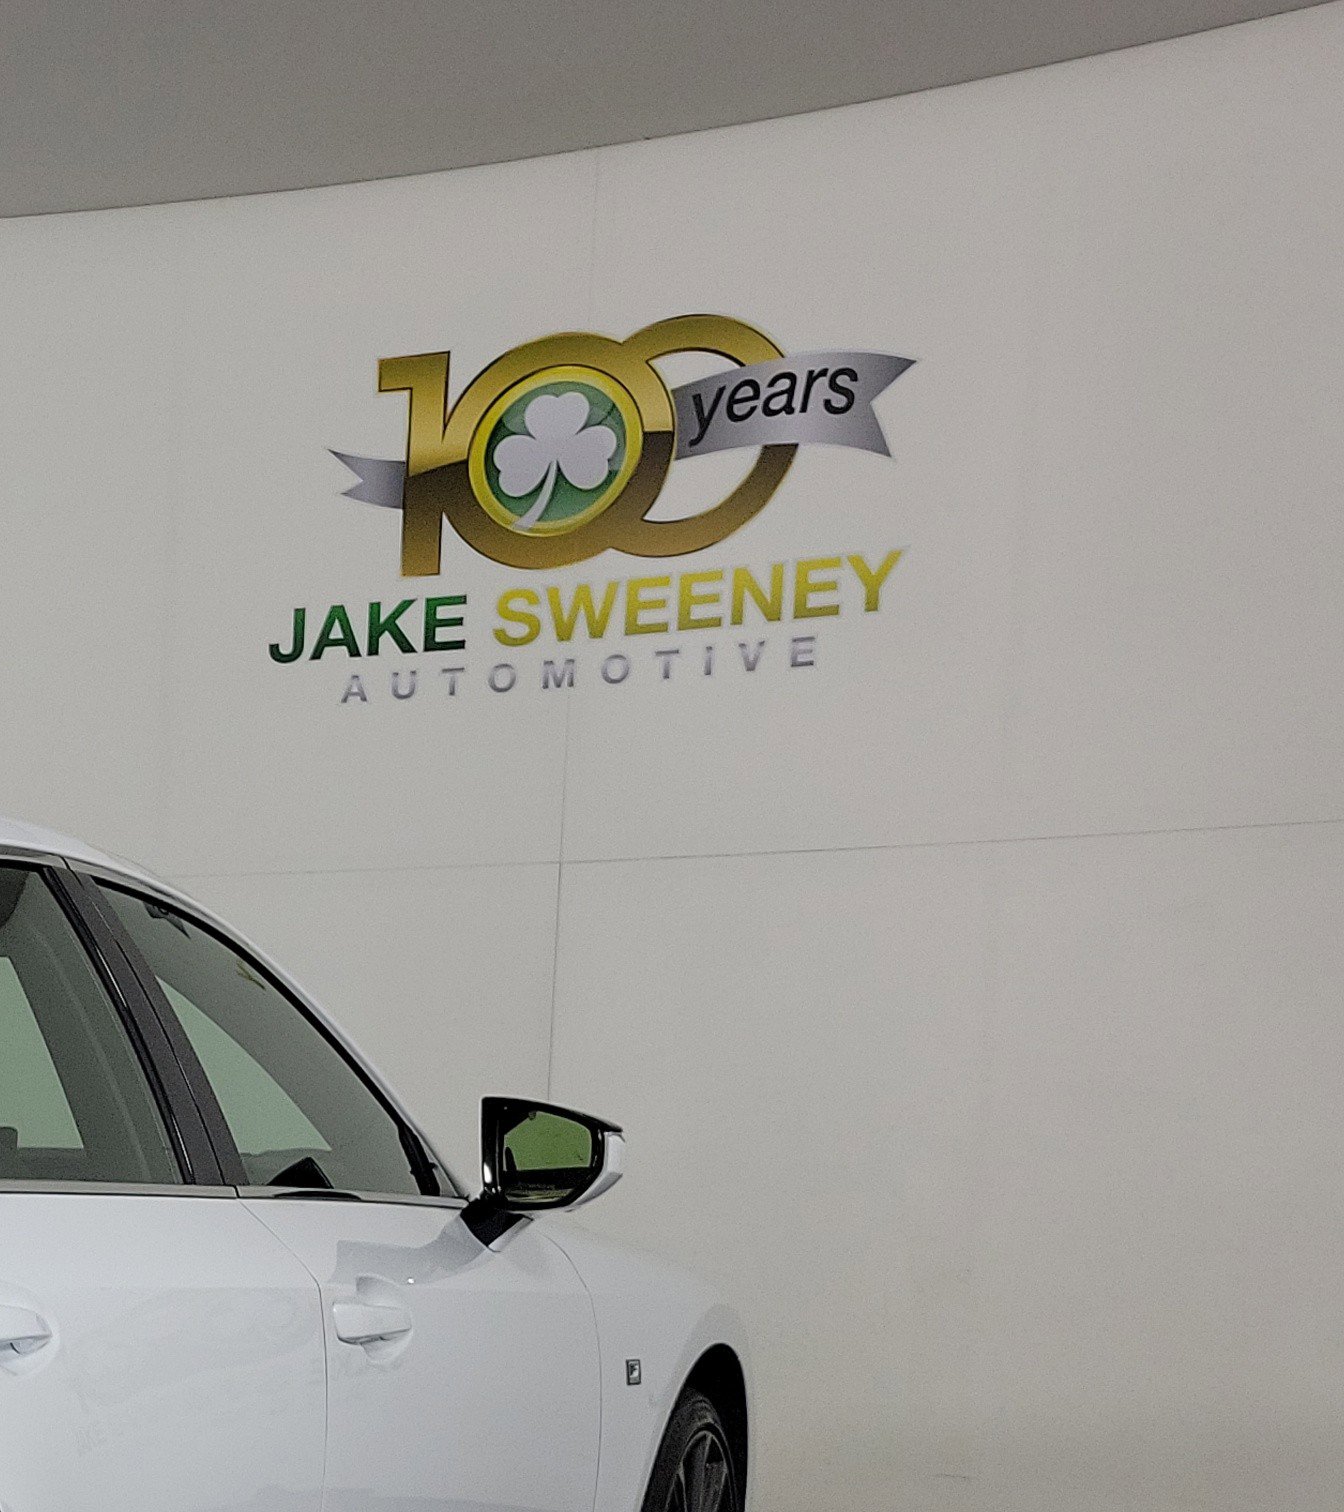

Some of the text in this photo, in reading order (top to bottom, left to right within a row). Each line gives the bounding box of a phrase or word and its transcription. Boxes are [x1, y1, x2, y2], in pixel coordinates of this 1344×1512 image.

[377, 313, 859, 578] 100 years
[268, 550, 903, 664] JAKE SWEENEY
[340, 635, 817, 704] AUTOMOTIVE
